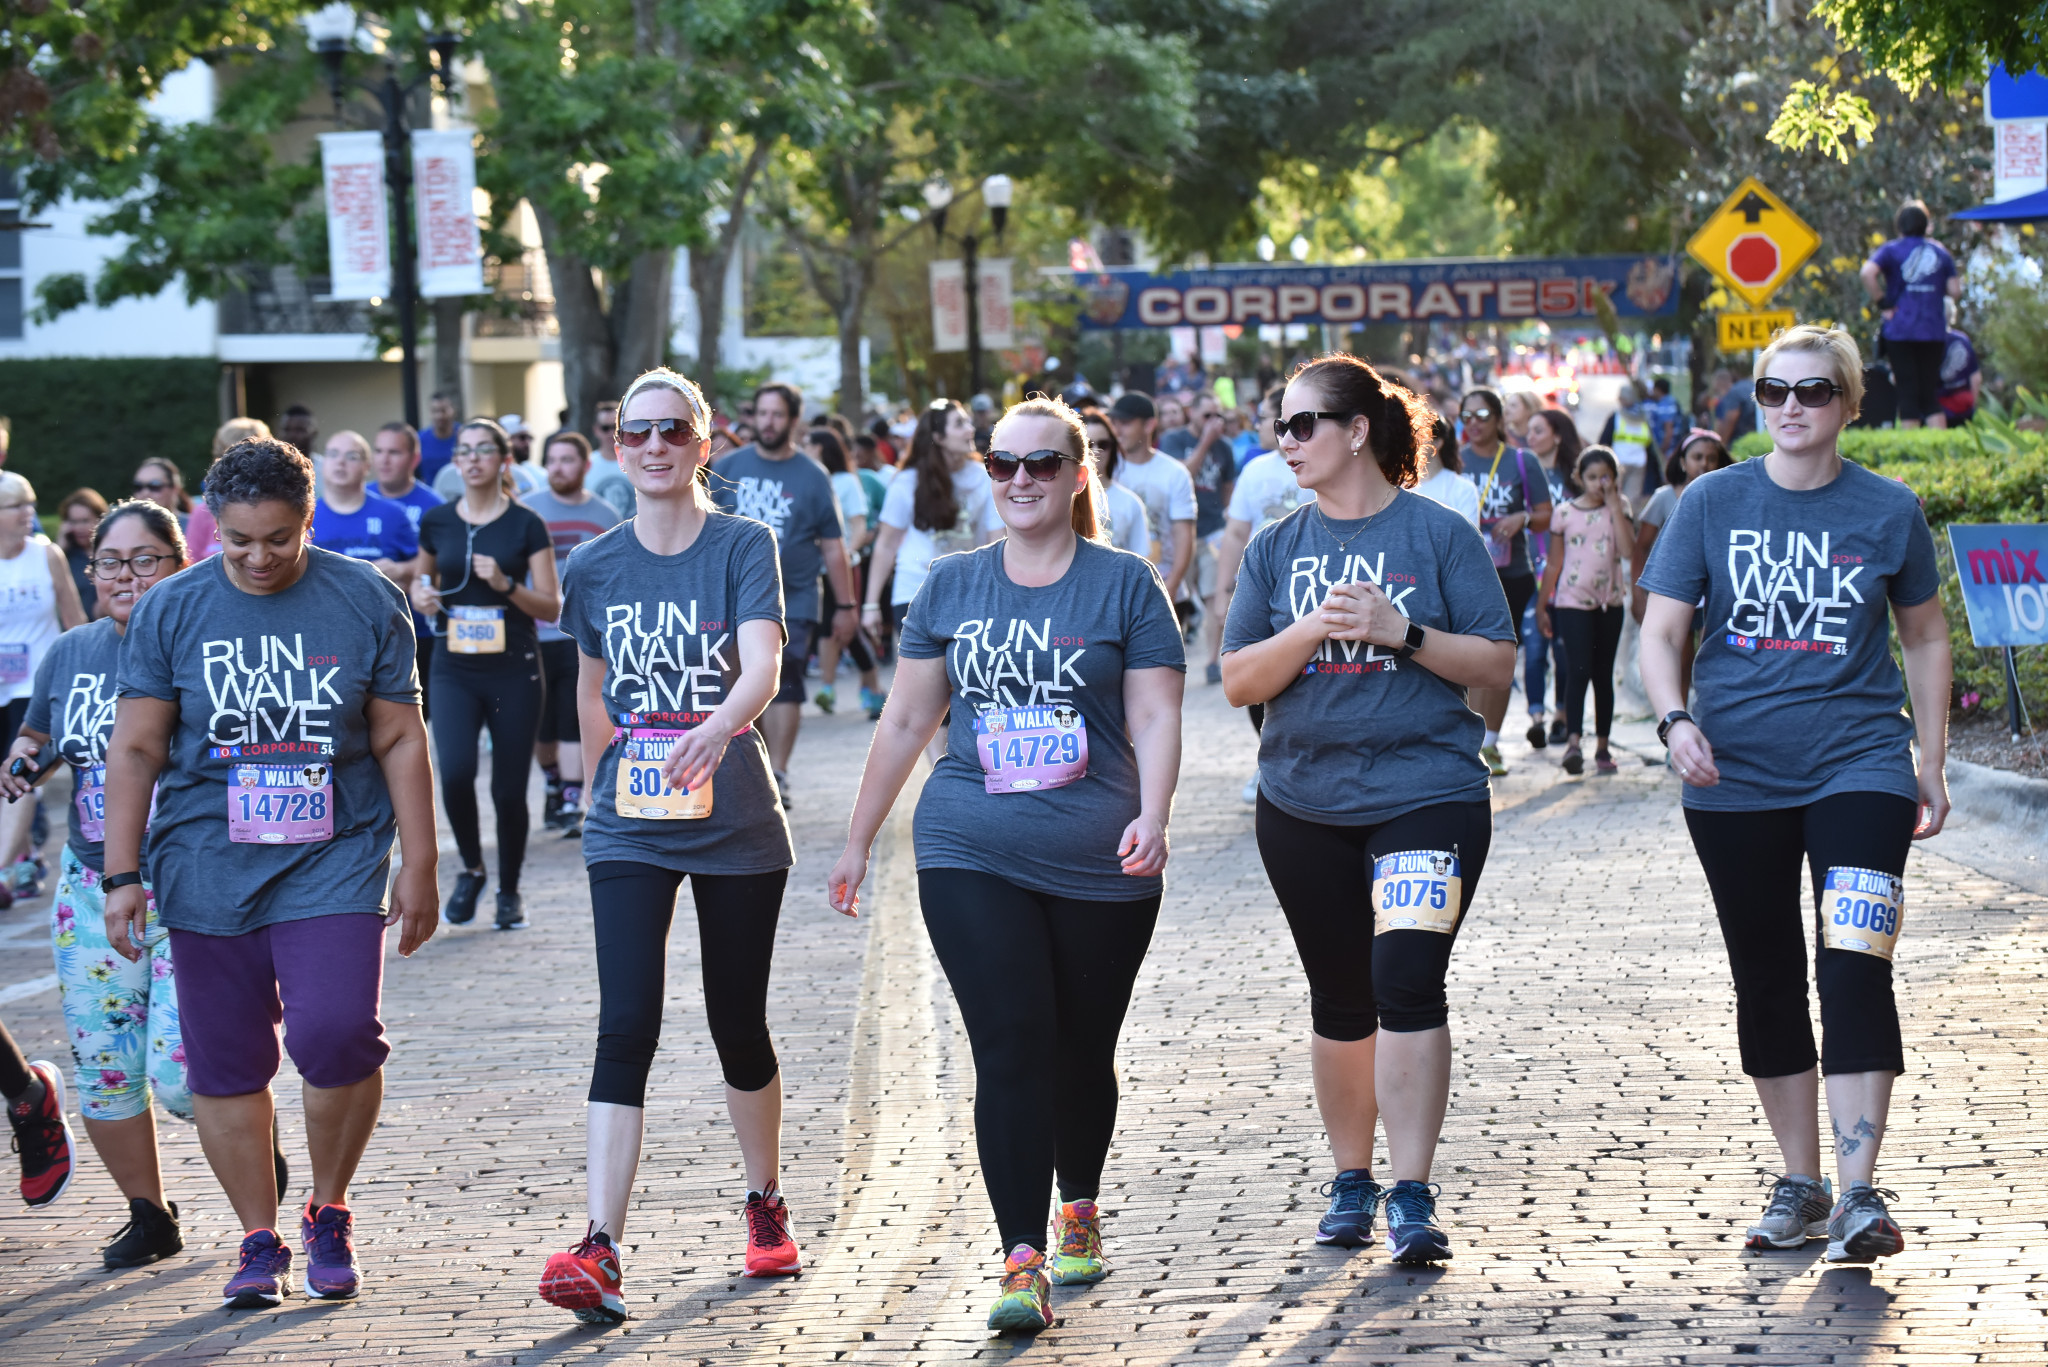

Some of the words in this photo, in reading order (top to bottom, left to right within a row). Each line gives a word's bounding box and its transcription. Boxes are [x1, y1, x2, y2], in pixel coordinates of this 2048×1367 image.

[1190, 269, 1324, 286] Insurance
[1330, 266, 1411, 283] Office
[1417, 264, 1445, 281] of
[1459, 262, 1565, 280] America
[1728, 529, 1829, 569] RUN
[1832, 554, 1863, 564] 2018
[1967, 538, 2047, 585] mix
[1291, 552, 1385, 588] RUN
[1386, 573, 1416, 584] 2018
[1728, 564, 1865, 604] WALK
[605, 600, 697, 639] RUN
[1289, 584, 1416, 622] WK
[1727, 597, 1851, 644] GIVE
[202, 633, 304, 676] RUN
[308, 656, 338, 666] 2018
[606, 633, 731, 677] WALK
[953, 618, 1051, 654] RUN
[1053, 637, 1084, 646] 2018
[1727, 635, 1756, 649] IOA
[1757, 638, 1833, 654] CORPORATE
[953, 648, 1087, 690] WALK
[1317, 662, 1383, 674] CORPORATE
[67, 673, 118, 705] RU
[204, 667, 344, 712] WALK
[611, 666, 722, 713] GIVE
[208, 700, 333, 745] GIVE
[1013, 711, 1053, 729] WALK
[242, 742, 319, 756] CORPORATE
[986, 733, 1081, 771] 14729
[264, 770, 303, 787] WALK
[237, 791, 327, 822] 14728
[1398, 855, 1428, 873] RUN
[1382, 879, 1447, 910] 3075
[1857, 873, 1888, 896] RUN
[1833, 896, 1898, 937] 3069
